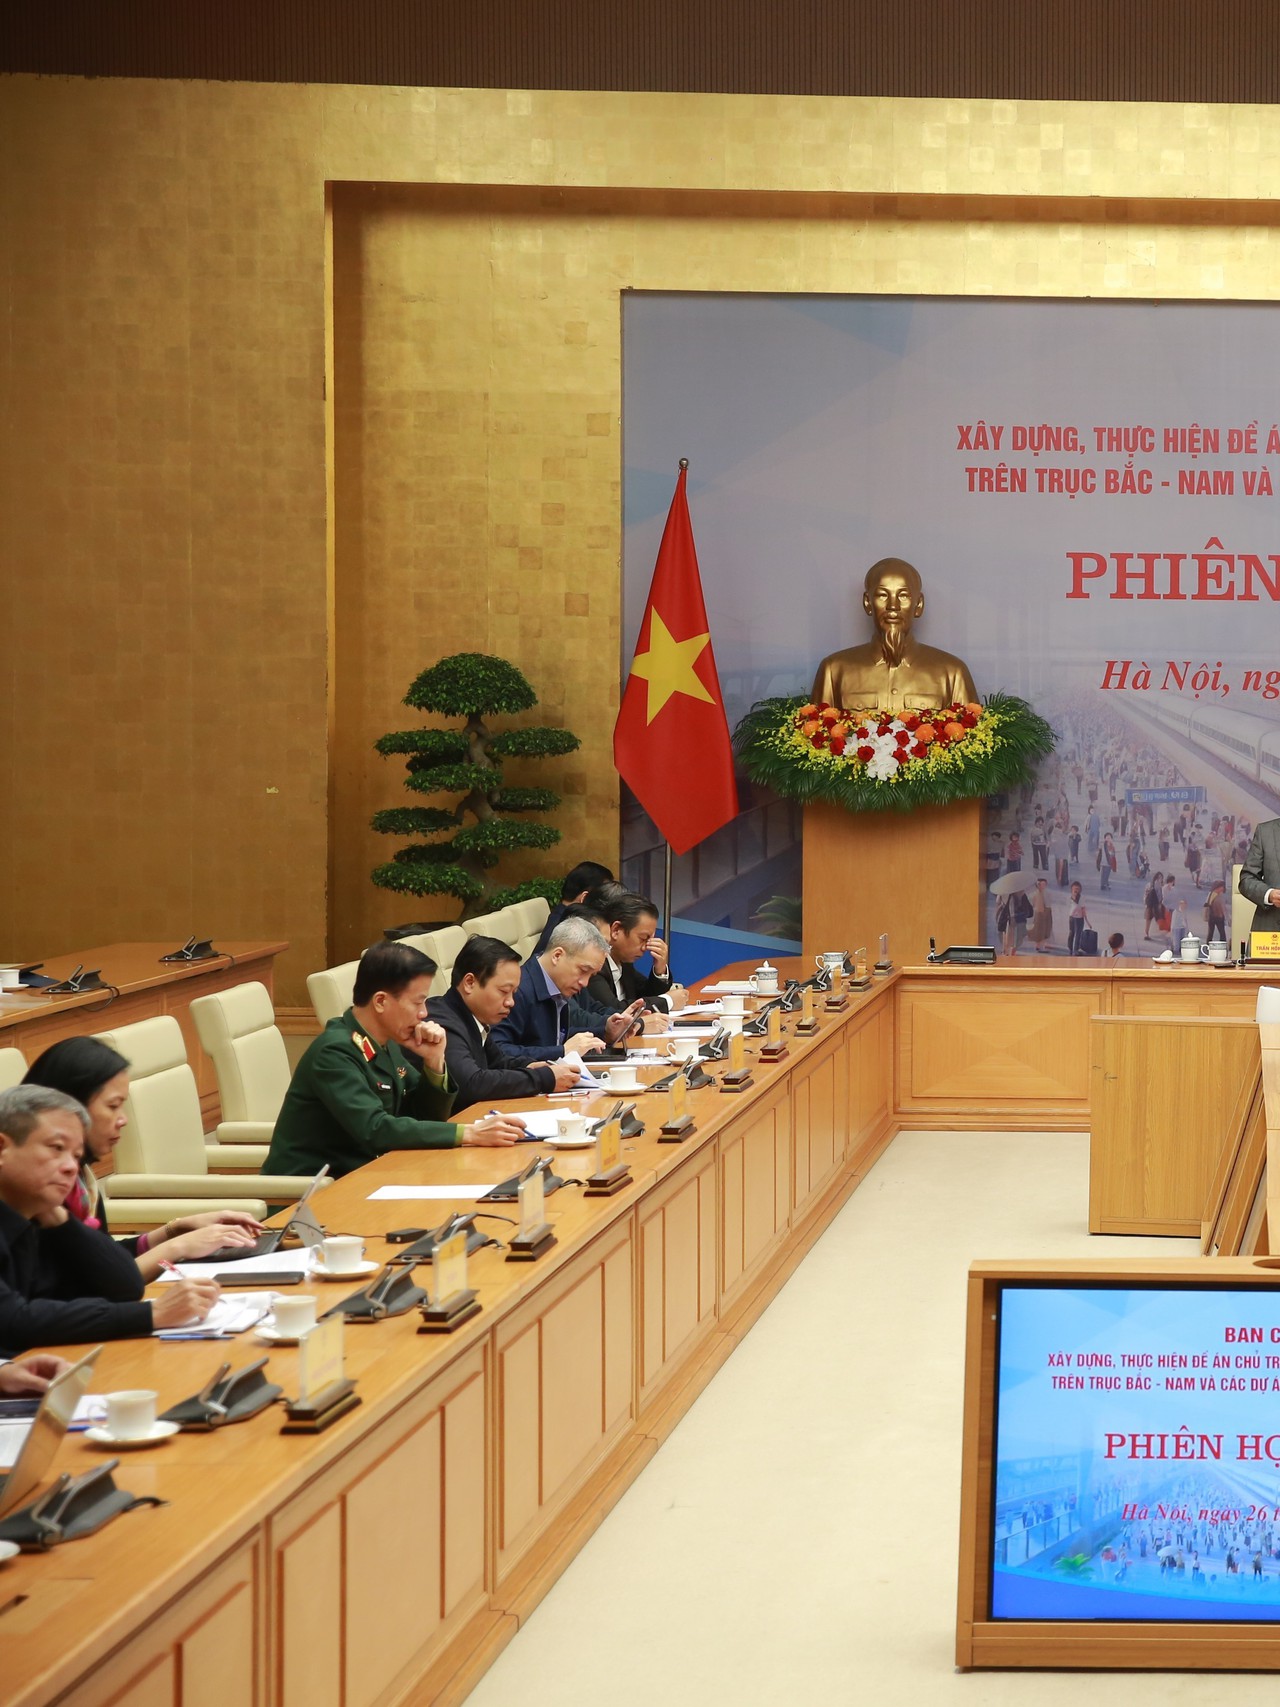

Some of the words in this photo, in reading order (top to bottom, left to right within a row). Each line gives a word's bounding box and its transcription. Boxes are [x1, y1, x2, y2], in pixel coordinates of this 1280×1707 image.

[957, 420, 1003, 451] XÂY
[1011, 424, 1086, 456] DỰNG,
[1093, 425, 1155, 458] THỰC
[1163, 423, 1220, 458] HIỆN
[1227, 420, 1258, 454] ĐỀ
[965, 462, 1028, 493] TRÊN
[1034, 468, 1097, 499] TRỤC
[1104, 461, 1153, 495] BẮC
[1178, 469, 1234, 496] NAM
[1241, 465, 1273, 496] VÀ
[1101, 660, 1152, 691] Hà
[1160, 660, 1231, 700] Nội,
[1225, 1327, 1263, 1343] BAN
[1048, 1351, 1072, 1367] XÂY
[1077, 1353, 1116, 1369] DỰNG,
[1121, 1354, 1153, 1370] THỰC
[1158, 1352, 1188, 1371] HIỆN
[1213, 1352, 1231, 1369] ÁN
[1235, 1350, 1260, 1369] CHỦ
[1052, 1373, 1084, 1389] TRÊN
[1089, 1376, 1121, 1392] TRỤC
[1126, 1372, 1152, 1390] BẮC
[1165, 1377, 1195, 1390] NAM
[1200, 1375, 1216, 1391] VÀ
[1220, 1375, 1245, 1391] CÁC
[1251, 1377, 1269, 1394] DỰ
[1104, 1425, 1224, 1459] PHIÊN
[1121, 1503, 1148, 1520] Hà
[1197, 1505, 1241, 1526] ngày
[1246, 1505, 1268, 1521] 26
